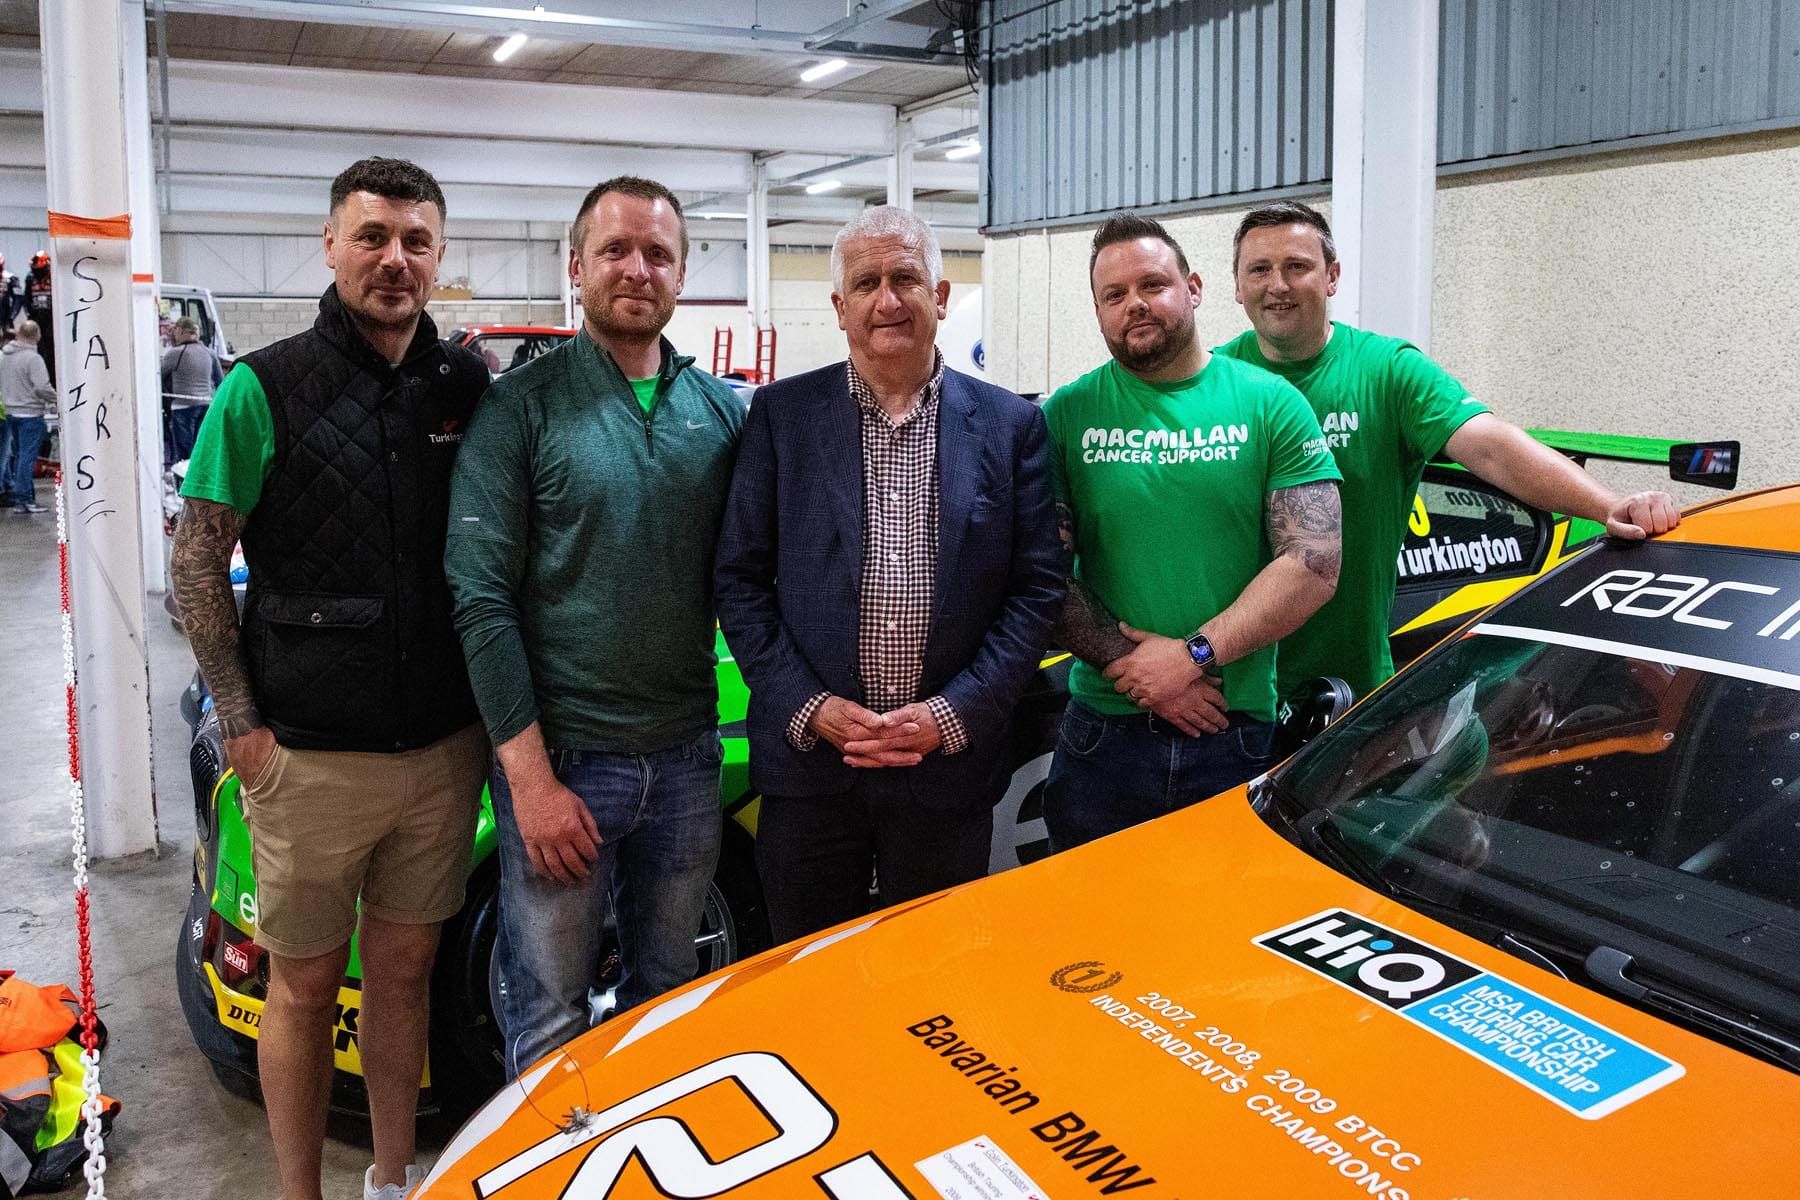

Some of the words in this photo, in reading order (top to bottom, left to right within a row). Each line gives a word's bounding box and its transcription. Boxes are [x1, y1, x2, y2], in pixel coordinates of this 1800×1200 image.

[65, 257, 112, 490] STAIRS
[1082, 424, 1248, 449] MACMILLAN
[1083, 448, 1153, 464] CANCER
[1158, 446, 1240, 465] SUPPORT
[1322, 411, 1359, 432] AN
[1327, 433, 1351, 448] RT
[1396, 533, 1523, 577] Turkington
[1277, 918, 1446, 1000] HiQ
[1428, 1004, 1600, 1095] CHAMPIONSHIP
[1450, 993, 1550, 1045] TOURING
[1543, 1042, 1600, 1074] CAR
[1467, 985, 1520, 1013] MSA
[1516, 1010, 1616, 1062] BRITISH
[906, 1014, 1041, 1115] Bavarian
[1030, 1111, 1158, 1196] BMW
[1088, 994, 1249, 1094] INDEPENDENTS
[1245, 1094, 1410, 1200] CHAMPIONS
[1135, 991, 1197, 1028] 2007,
[1194, 1026, 1262, 1071] 2008,
[1263, 1069, 1337, 1115] 2009
[1334, 1115, 1422, 1173] BTCC
